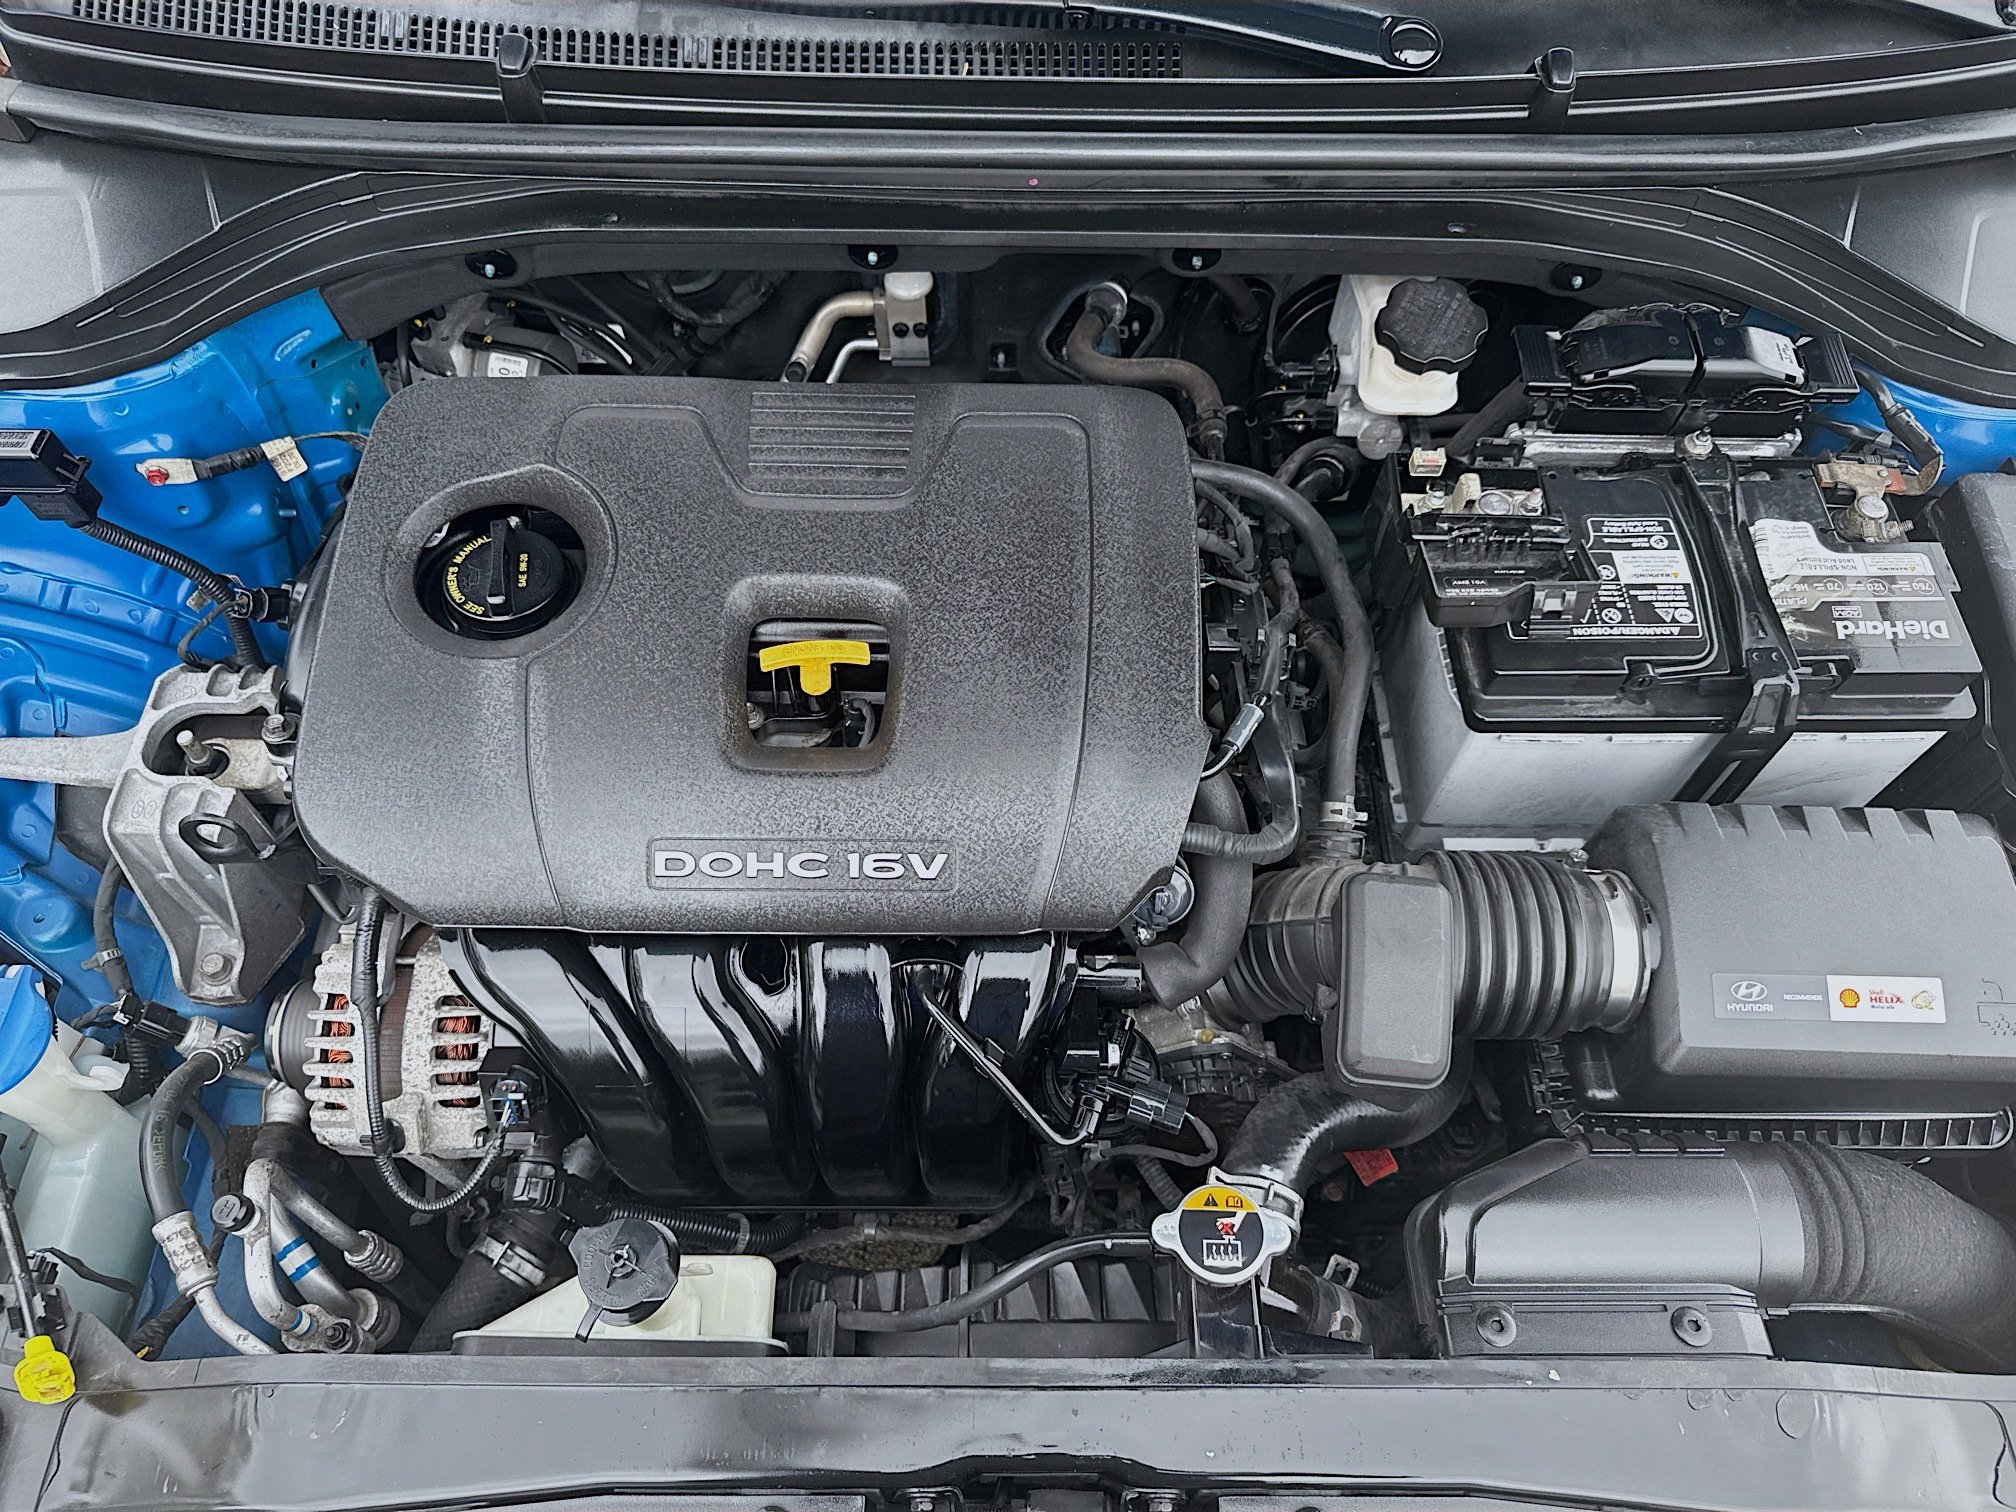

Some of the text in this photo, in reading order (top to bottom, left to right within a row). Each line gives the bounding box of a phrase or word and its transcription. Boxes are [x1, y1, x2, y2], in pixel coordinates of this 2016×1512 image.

[446, 535, 492, 615] SEE OWNER'S MANUAL
[517, 553, 529, 588] SAE 5W-20
[1826, 582, 1841, 591] 70
[1866, 582, 1886, 592] 120
[1911, 582, 1932, 591] 760
[1572, 626, 1669, 636] DANGER/POISON
[1835, 620, 1950, 640] DieHard
[783, 643, 821, 656] ENGINE
[653, 850, 949, 880] DOHC 16V
[1783, 993, 1823, 1002] RECOMMENDS
[1868, 989, 1885, 997] Shell
[1869, 995, 1903, 1004] HELIX
[1726, 1003, 1774, 1013] HYUNDAI
